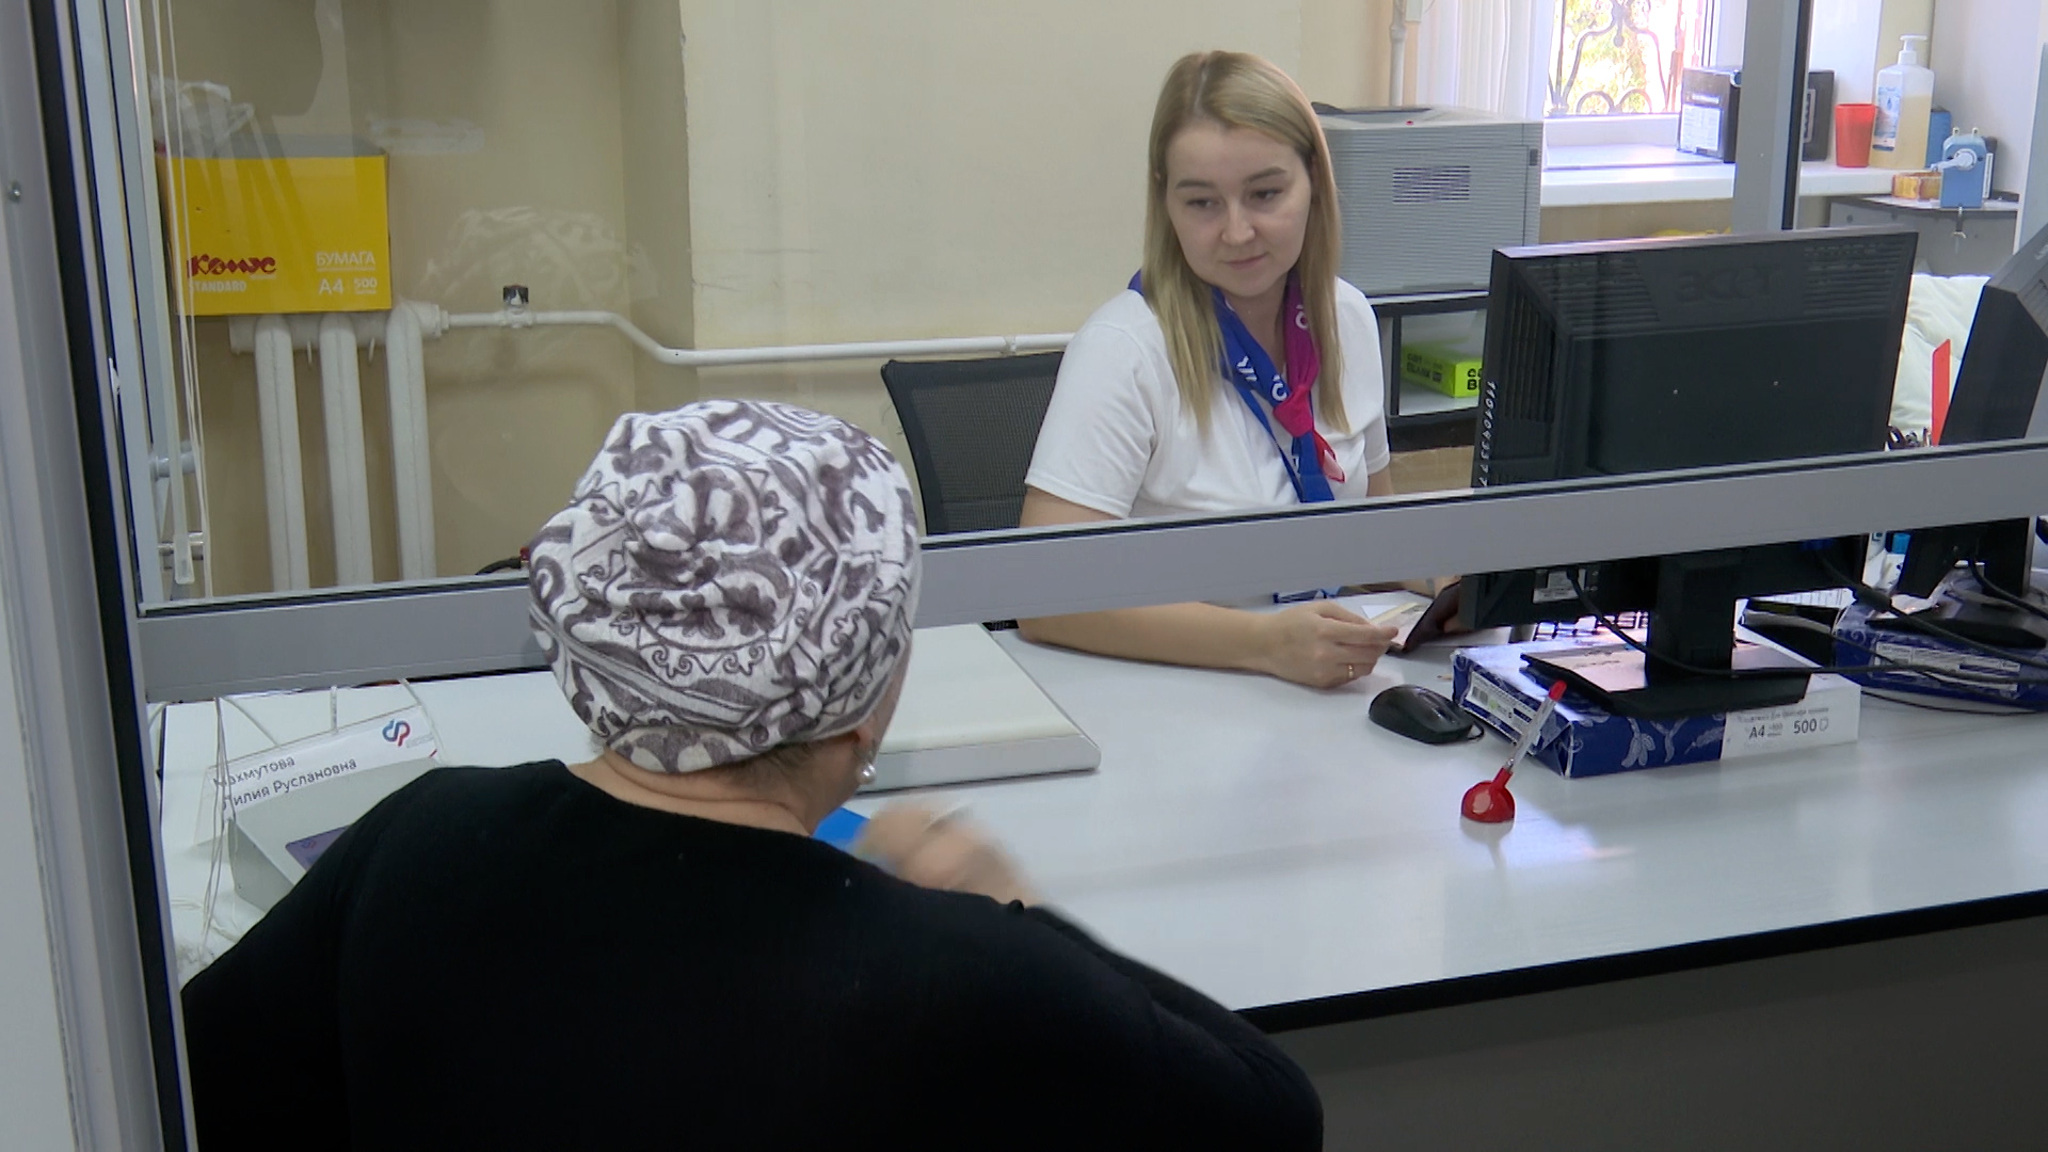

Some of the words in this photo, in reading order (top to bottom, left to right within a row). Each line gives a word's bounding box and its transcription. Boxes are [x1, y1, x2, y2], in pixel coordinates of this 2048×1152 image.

[316, 252, 375, 267] БУМАГА
[319, 278, 344, 295] A4
[354, 277, 377, 288] 500
[1793, 718, 1818, 734] 500
[273, 758, 357, 793] Руслановна
